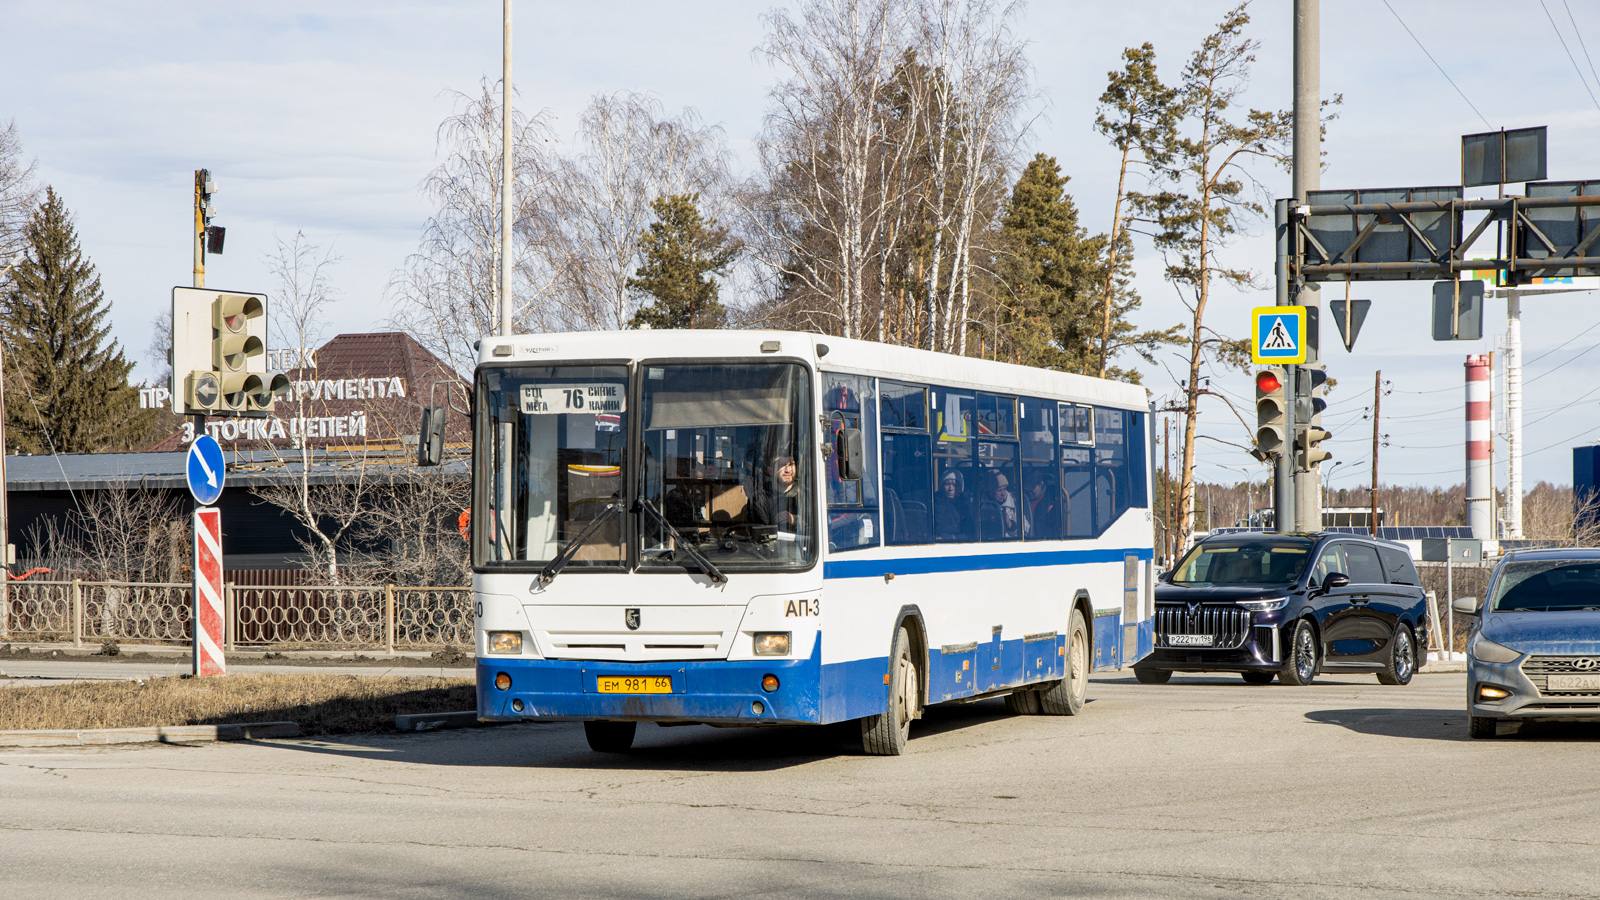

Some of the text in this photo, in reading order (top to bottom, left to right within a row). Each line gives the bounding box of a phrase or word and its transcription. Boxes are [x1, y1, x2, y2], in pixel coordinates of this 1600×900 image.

[275, 377, 406, 402] ТРУМЕНТА
[525, 387, 543, 399] СТЦ
[588, 386, 616, 397] СИНИЕ
[563, 389, 584, 409] 76
[589, 401, 620, 410] КАМНИ
[526, 402, 548, 411] МЕГА
[181, 416, 287, 442] ЗТОЧКА
[604, 677, 668, 691] ЕМ 981 66
